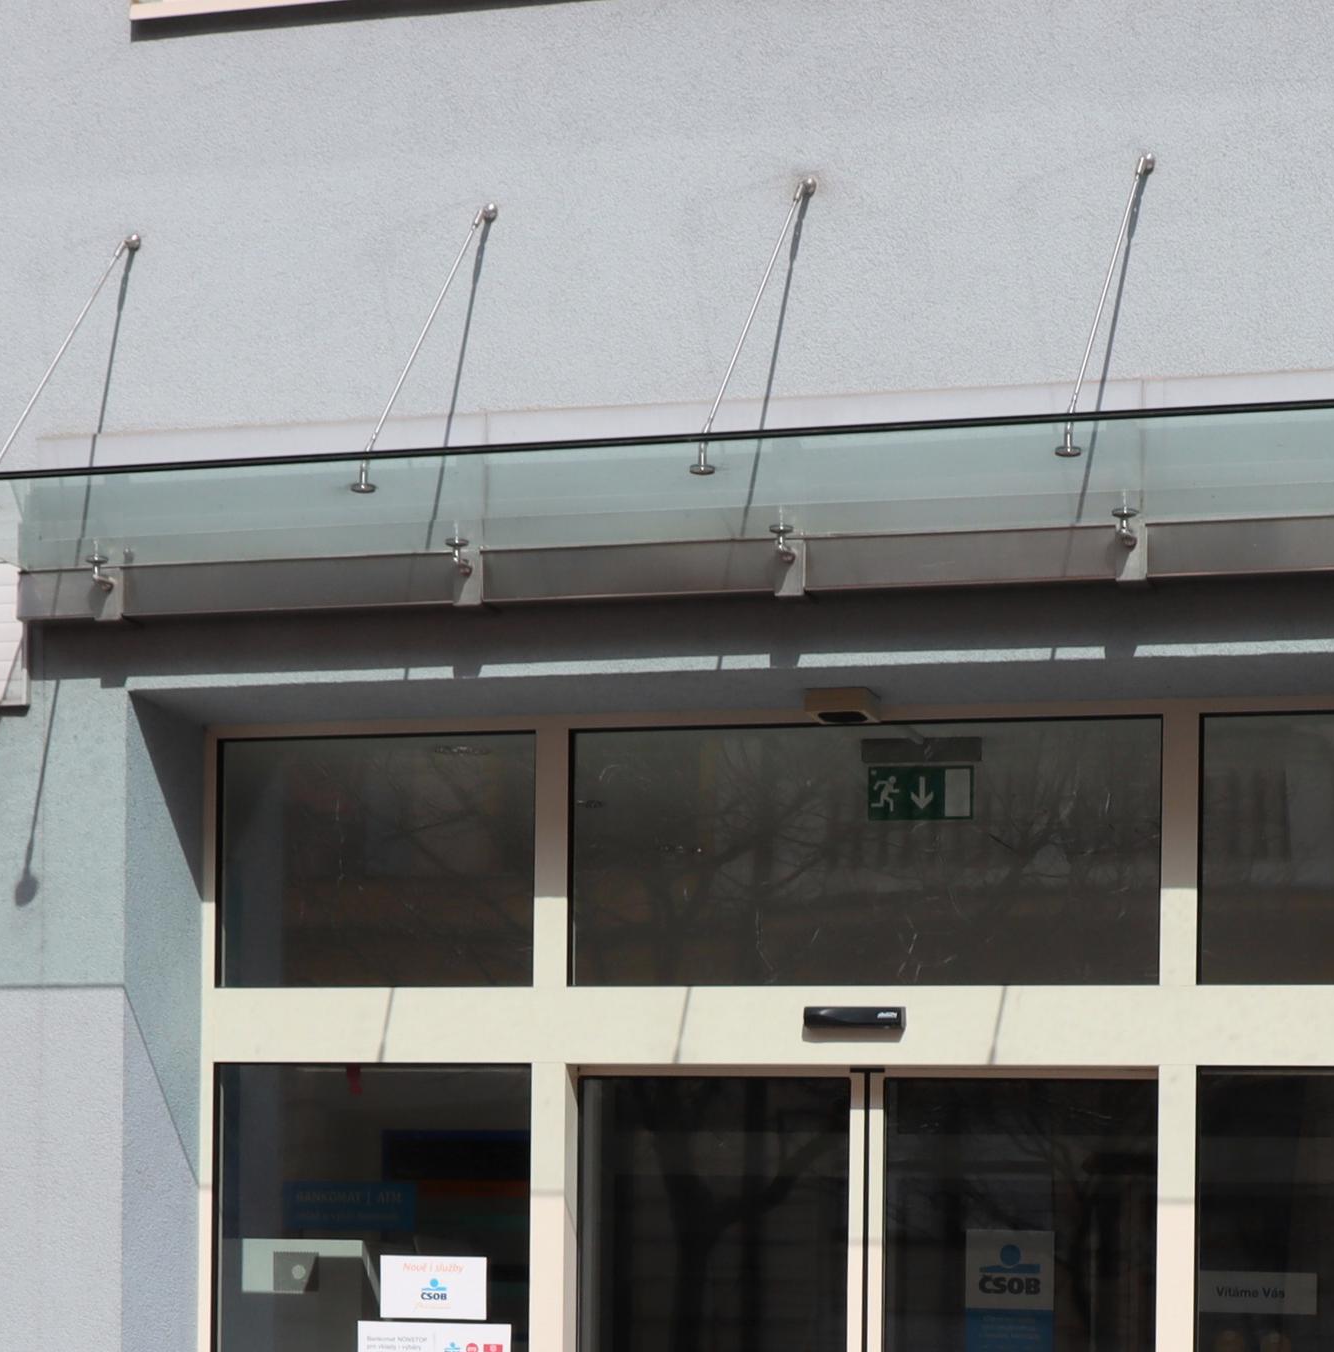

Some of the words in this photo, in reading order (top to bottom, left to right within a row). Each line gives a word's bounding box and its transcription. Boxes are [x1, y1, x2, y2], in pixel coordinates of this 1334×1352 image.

[979, 1275, 1041, 1295] ČSOB
[1215, 1285, 1259, 1299] Vítáme
[1262, 1285, 1285, 1300] Vás
[421, 1291, 447, 1301] ČSOB
